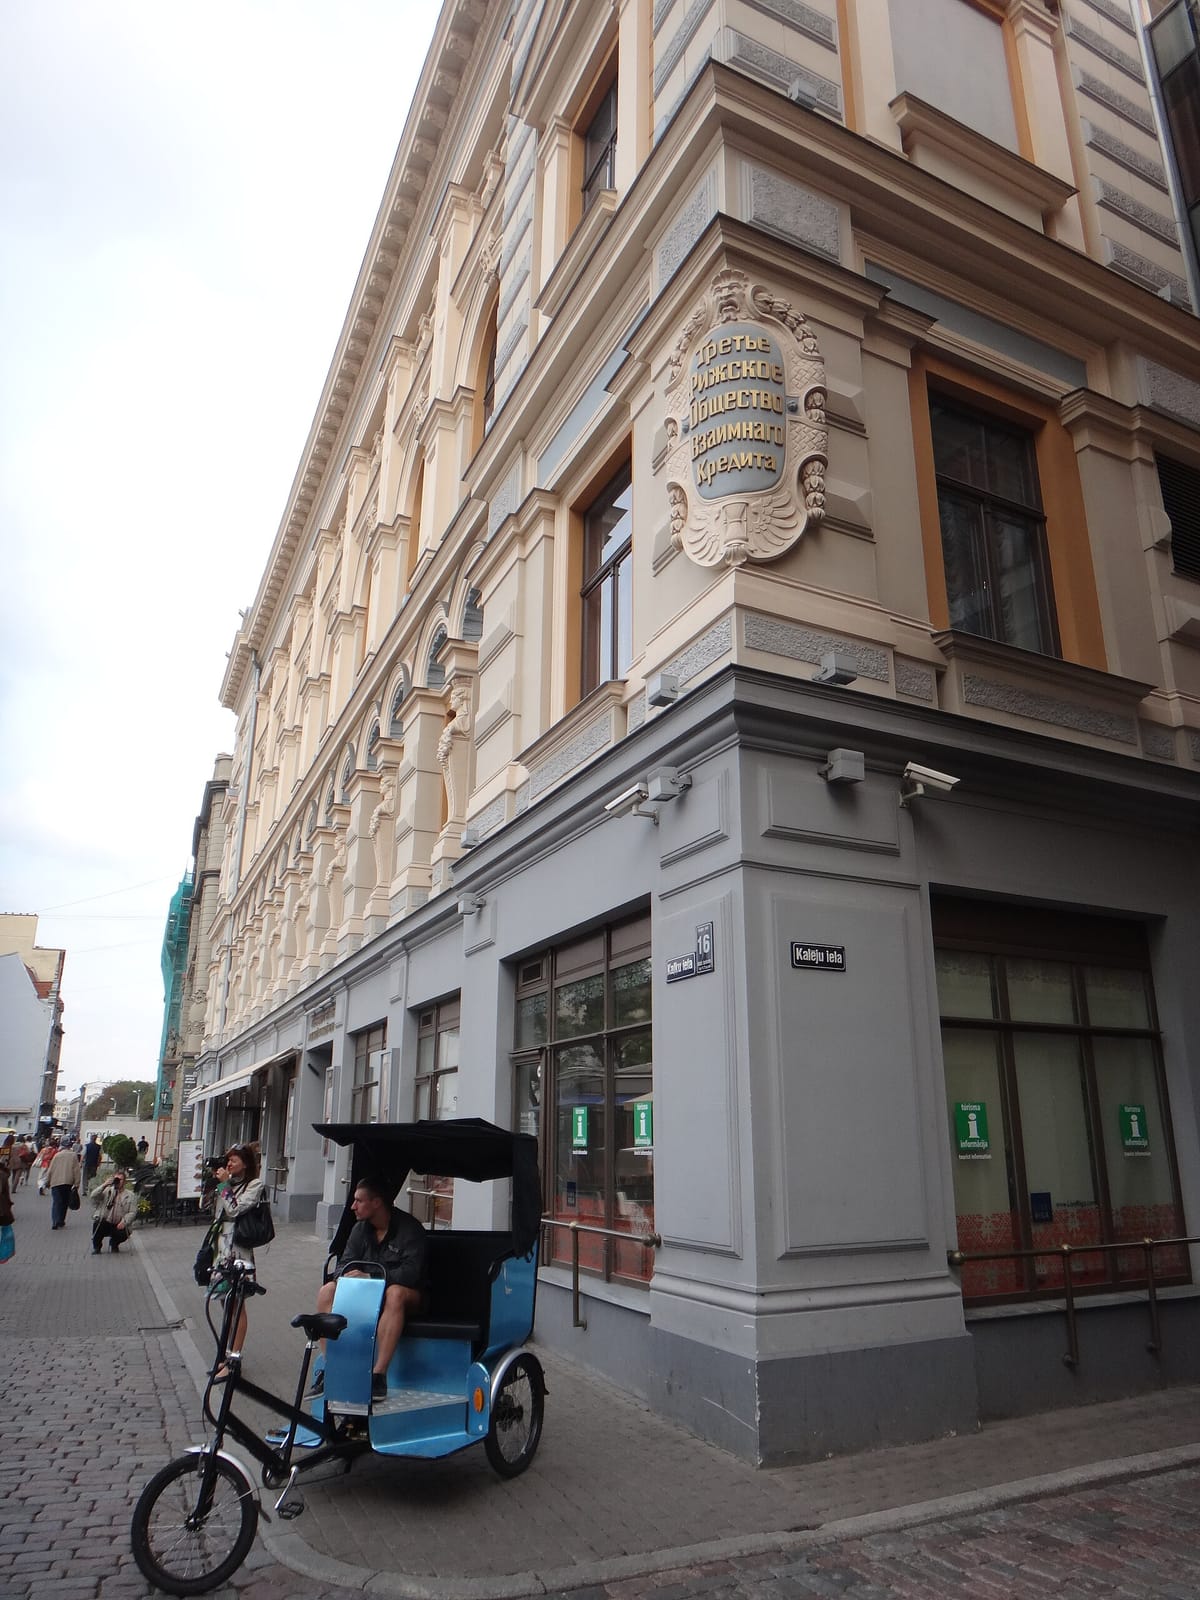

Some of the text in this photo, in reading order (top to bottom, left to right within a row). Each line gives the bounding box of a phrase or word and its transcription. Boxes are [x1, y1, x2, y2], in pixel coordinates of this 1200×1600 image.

[695, 335, 771, 369] Третье
[688, 359, 785, 404] Рижское
[689, 389, 784, 431] Общество
[696, 451, 777, 487] Кредита
[697, 934, 711, 955] 16
[826, 950, 843, 964] iela
[682, 957, 693, 971] iela
